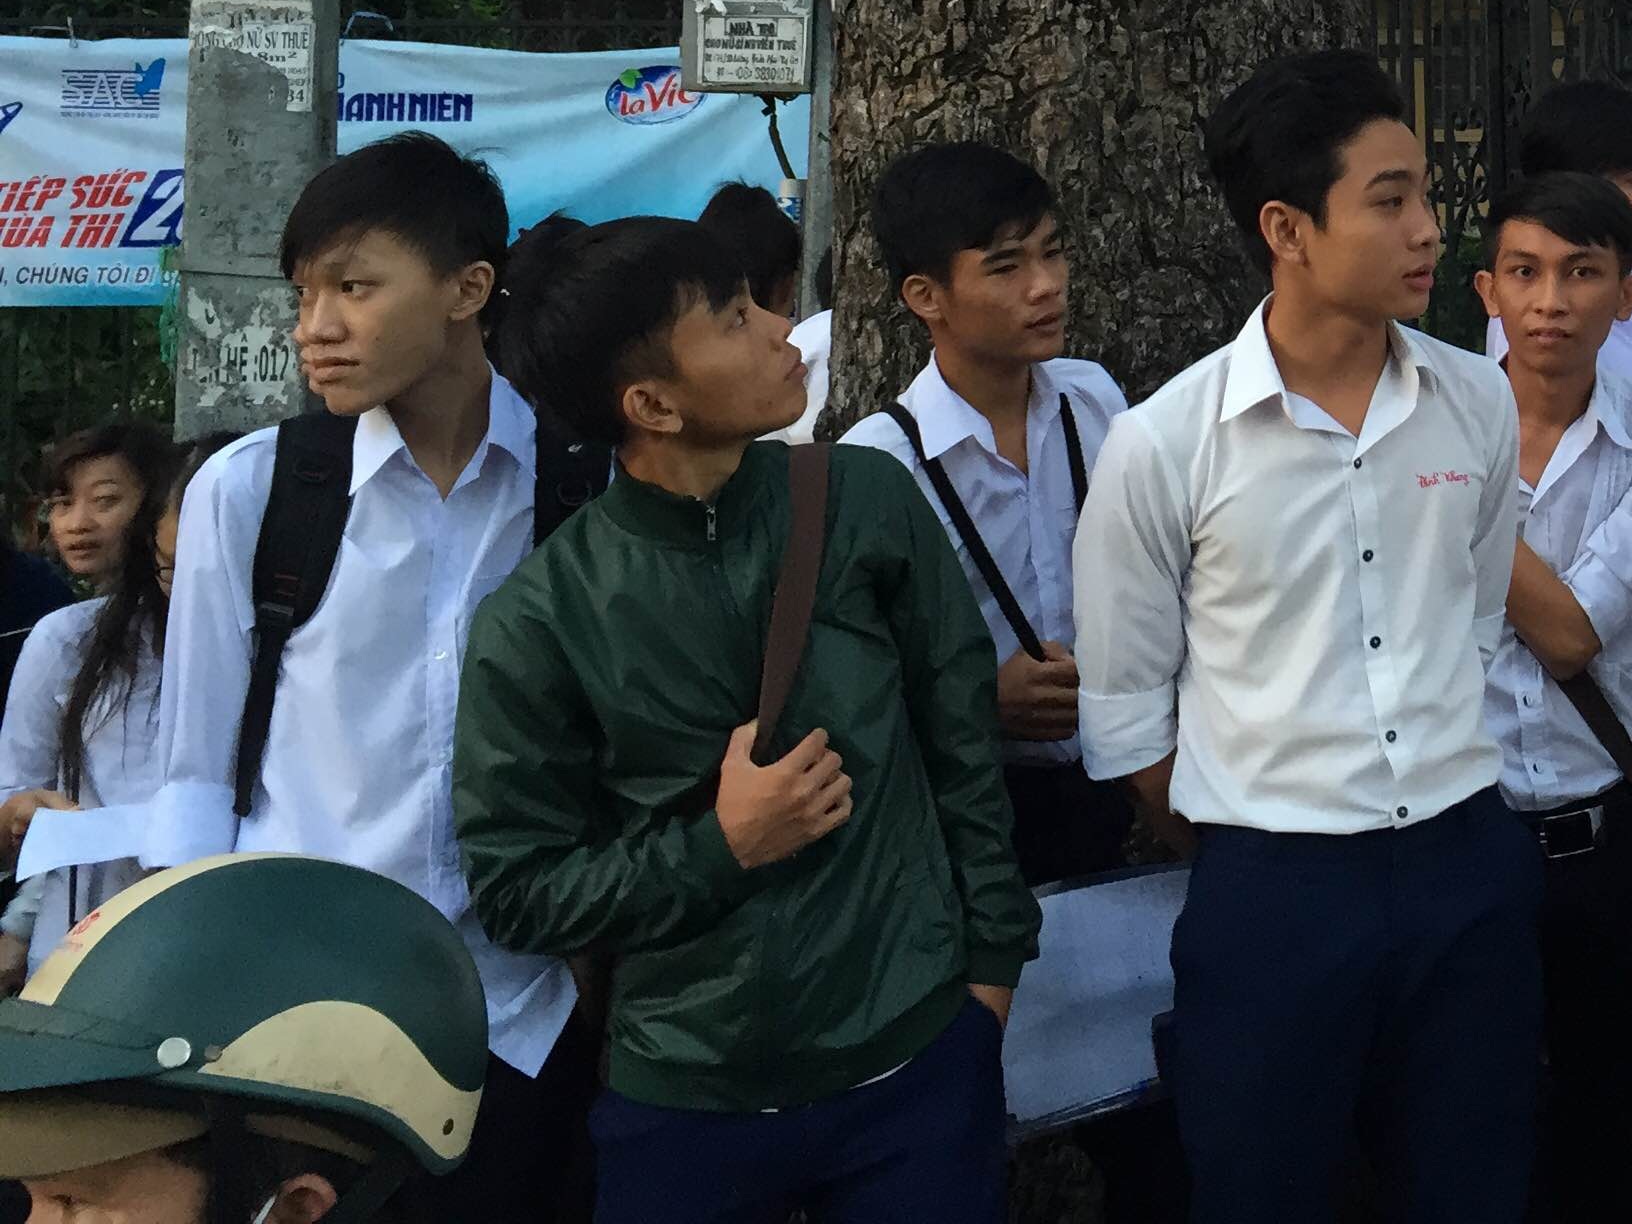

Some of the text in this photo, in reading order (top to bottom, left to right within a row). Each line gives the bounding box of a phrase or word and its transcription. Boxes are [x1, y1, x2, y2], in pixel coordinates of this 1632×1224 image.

[69, 168, 148, 210] SỨC
[60, 212, 126, 249] THI
[15, 262, 90, 285] CHÚNG
[97, 262, 130, 284] TÔI
